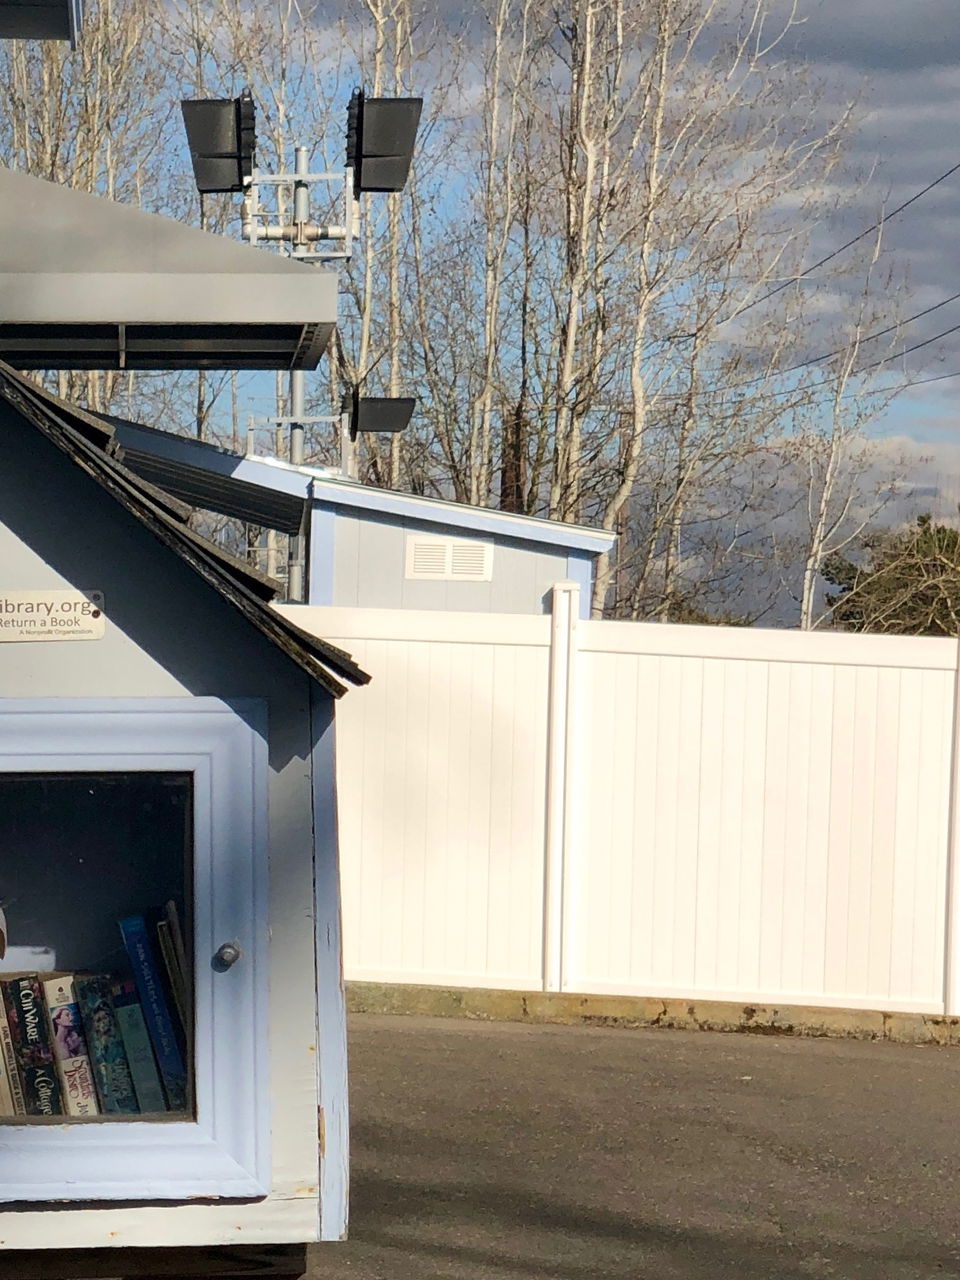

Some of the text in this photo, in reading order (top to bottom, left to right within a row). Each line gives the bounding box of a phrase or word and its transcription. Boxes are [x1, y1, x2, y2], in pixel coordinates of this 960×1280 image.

[40, 620, 47, 628] a
[51, 616, 81, 627] Book
[24, 1010, 40, 1042] WARE
[34, 1077, 53, 1116] Cottage
